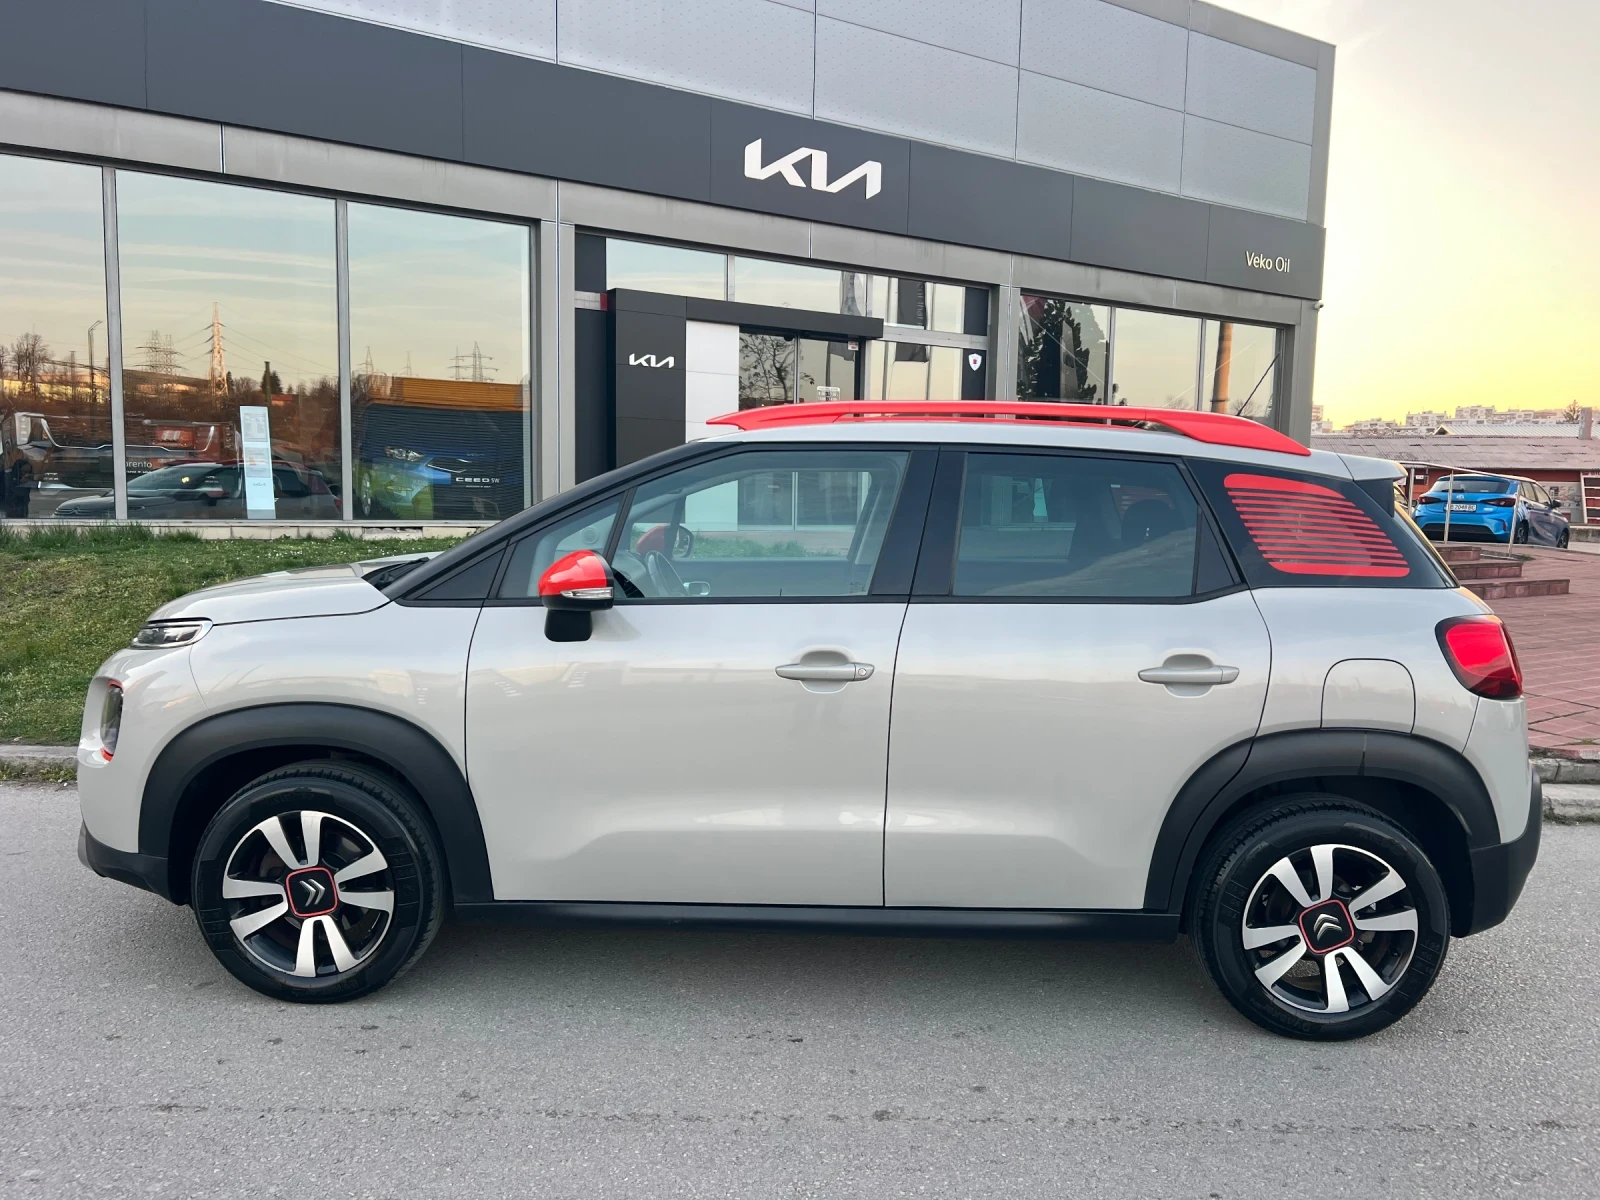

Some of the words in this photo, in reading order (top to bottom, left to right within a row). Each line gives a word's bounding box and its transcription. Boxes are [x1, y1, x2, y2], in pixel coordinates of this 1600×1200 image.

[744, 138, 882, 200] KIA
[1246, 251, 1273, 270] Veko
[1275, 256, 1291, 273] Oil
[629, 353, 675, 369] KIA
